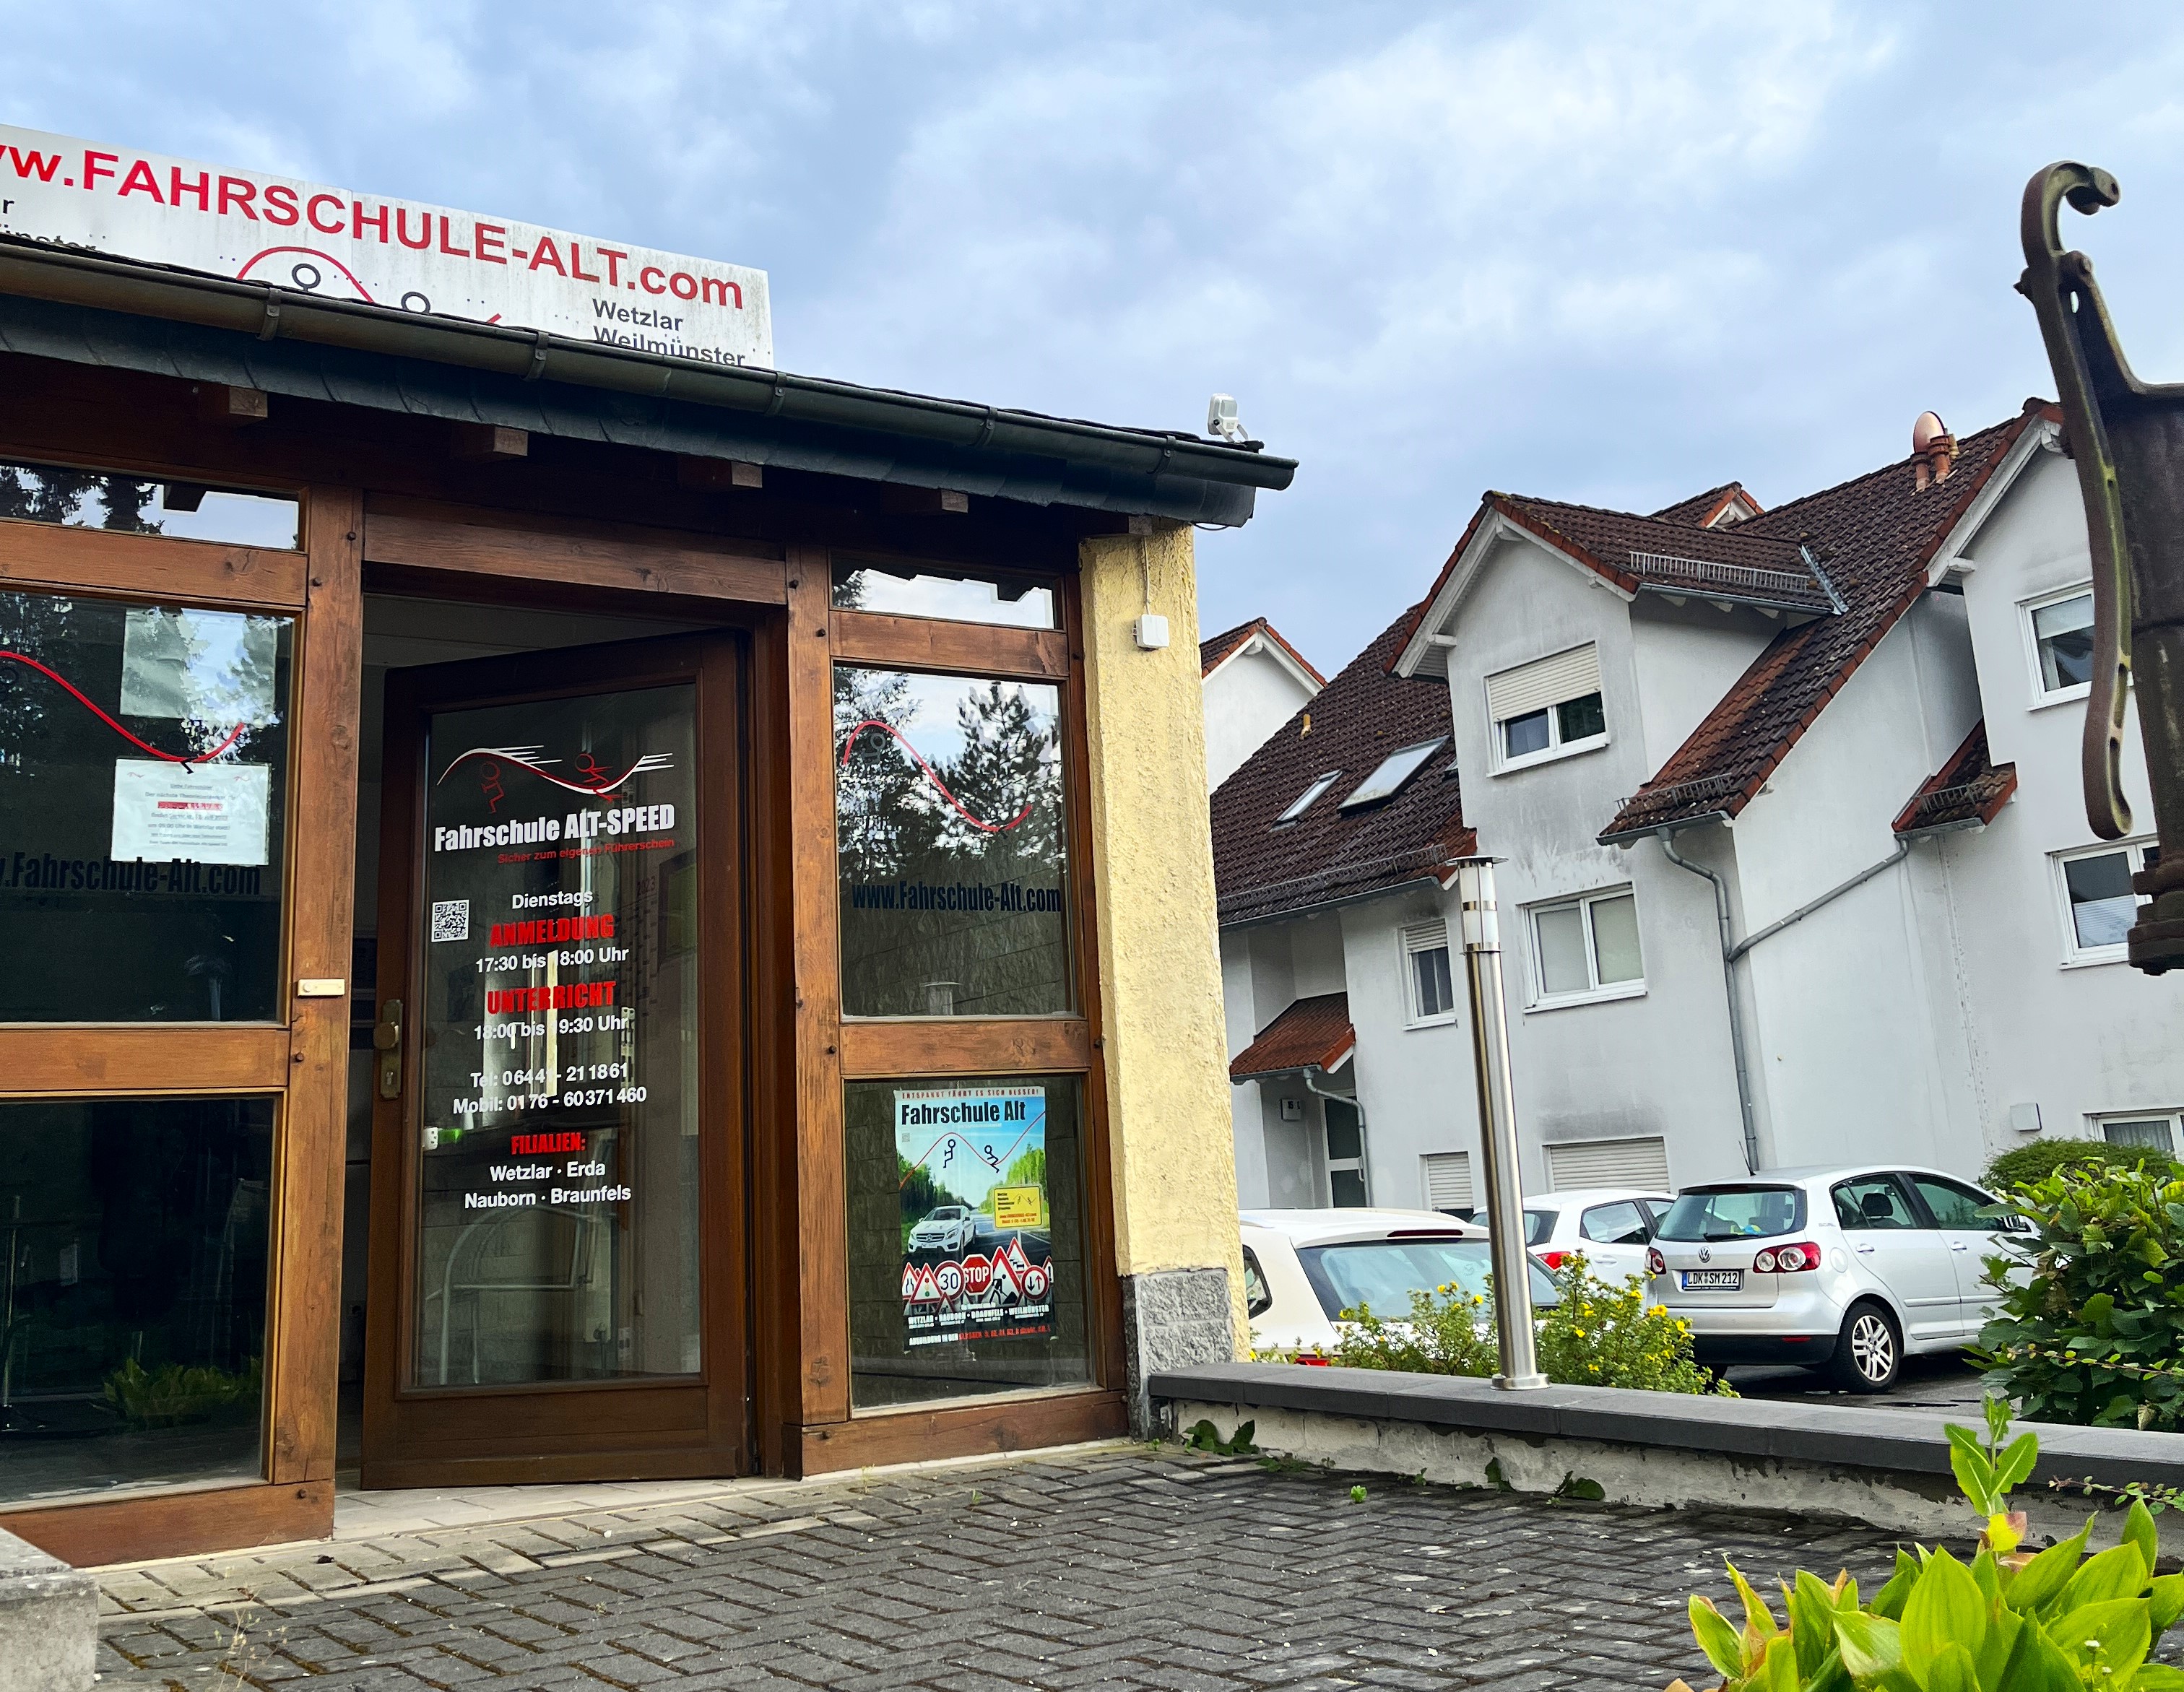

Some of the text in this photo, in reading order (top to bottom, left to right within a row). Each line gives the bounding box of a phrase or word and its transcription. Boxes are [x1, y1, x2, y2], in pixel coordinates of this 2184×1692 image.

[0, 144, 742, 309] w.FAHRSCHULE-ALT.com
[592, 298, 683, 331] Wetzlar
[594, 325, 745, 366] Weilmünster
[435, 804, 675, 852] Fahrschule ALT-SPEED
[498, 838, 675, 865] Sicher zum eigenen Führerschein
[512, 890, 593, 909] Dienstags
[852, 880, 1061, 912] www.Fahrschule-Alt.com
[490, 914, 614, 947] ANMELDUNG
[476, 955, 518, 973] 17:30
[522, 953, 546, 969] bis
[599, 946, 629, 963] Uhr
[488, 981, 616, 1014] UNTERRICHT
[474, 1023, 516, 1040] 18:00
[520, 1020, 545, 1037] bis
[598, 1015, 629, 1031] Uhr
[470, 1072, 498, 1088] Tel:
[453, 1097, 503, 1114] Mobil:
[901, 1100, 1026, 1125] Fahrschule Alt
[511, 1132, 586, 1155] FILIALIEN:
[490, 1160, 606, 1181] Wetzlar Erda
[464, 1185, 632, 1209] Nauborn Braunfels
[940, 1272, 958, 1290] 30
[964, 1266, 989, 1283] STOP
[1688, 1272, 1738, 1284] LDK SM 212
